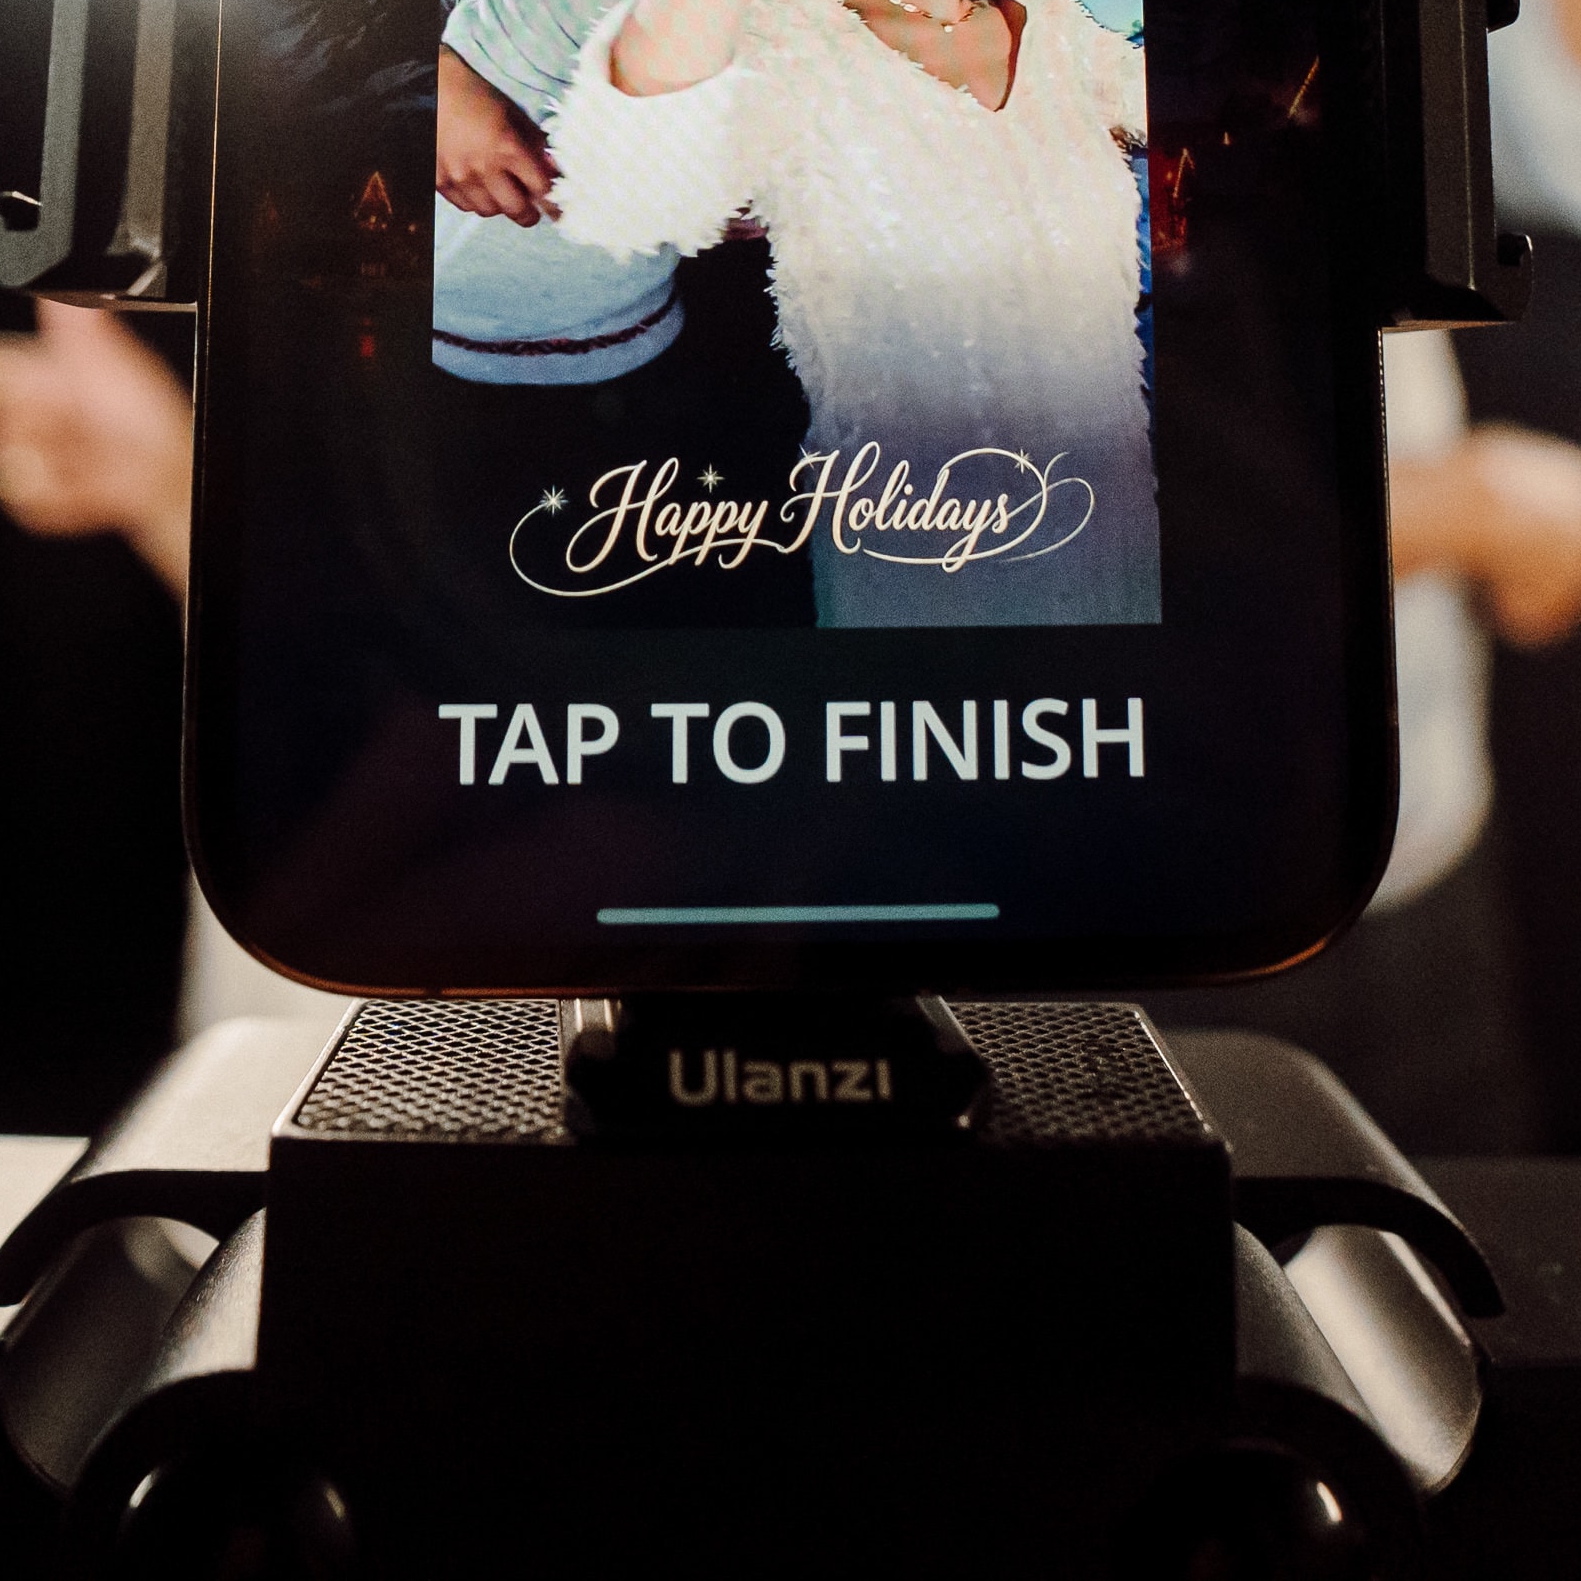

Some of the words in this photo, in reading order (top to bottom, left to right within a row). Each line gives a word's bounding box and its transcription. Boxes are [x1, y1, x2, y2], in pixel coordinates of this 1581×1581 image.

[565, 456, 770, 572] Happy
[780, 440, 1047, 573] Holidays
[438, 703, 621, 785] TAP
[650, 701, 787, 785] TO
[825, 697, 1145, 784] FINISH
[668, 1049, 893, 1106] Ulanzi
